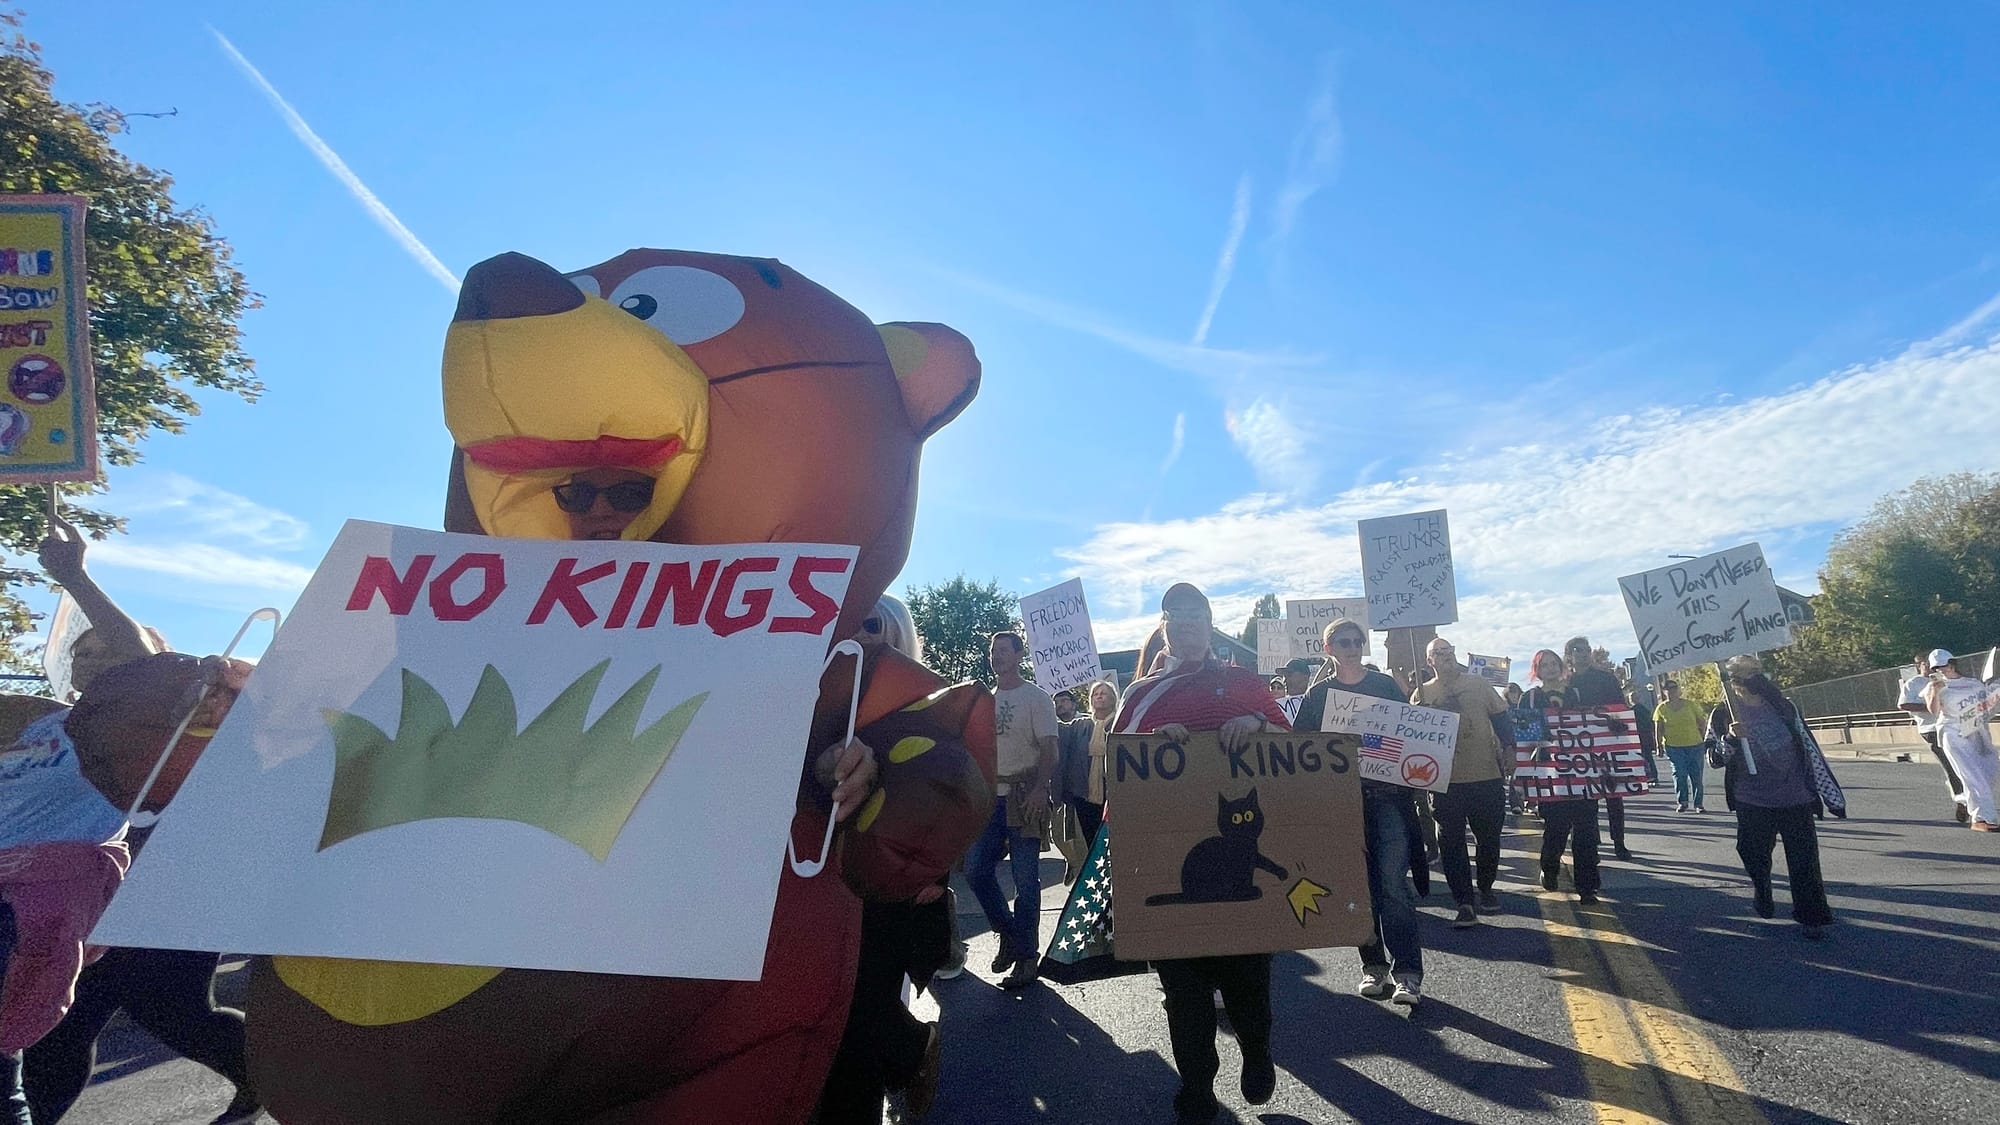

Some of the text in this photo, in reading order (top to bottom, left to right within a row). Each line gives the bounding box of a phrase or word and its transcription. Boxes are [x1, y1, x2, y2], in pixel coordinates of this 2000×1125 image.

[345, 552, 853, 637] NO KINGS
[1622, 574, 1662, 608] WE
[1716, 556, 1764, 586] NEED
[1030, 594, 1087, 632] FREEDOM
[1298, 603, 1347, 618] Liberty
[1676, 594, 1721, 617] THIS
[1052, 624, 1073, 640] AND
[1296, 622, 1319, 635] and
[1731, 600, 1785, 641] THANG
[1035, 633, 1092, 666] DEMOCRACY
[1471, 657, 1487, 667] NO
[1064, 653, 1092, 672] WHAT
[1049, 665, 1097, 690] WE WANT
[1333, 692, 1361, 712] WE
[1400, 705, 1450, 727] PEOPLE
[1330, 715, 1357, 727] HAVE
[1395, 724, 1453, 749] POWER!
[1556, 730, 1595, 749] DO
[1115, 738, 1350, 783] NO KINGS
[1553, 750, 1634, 775] SOME
